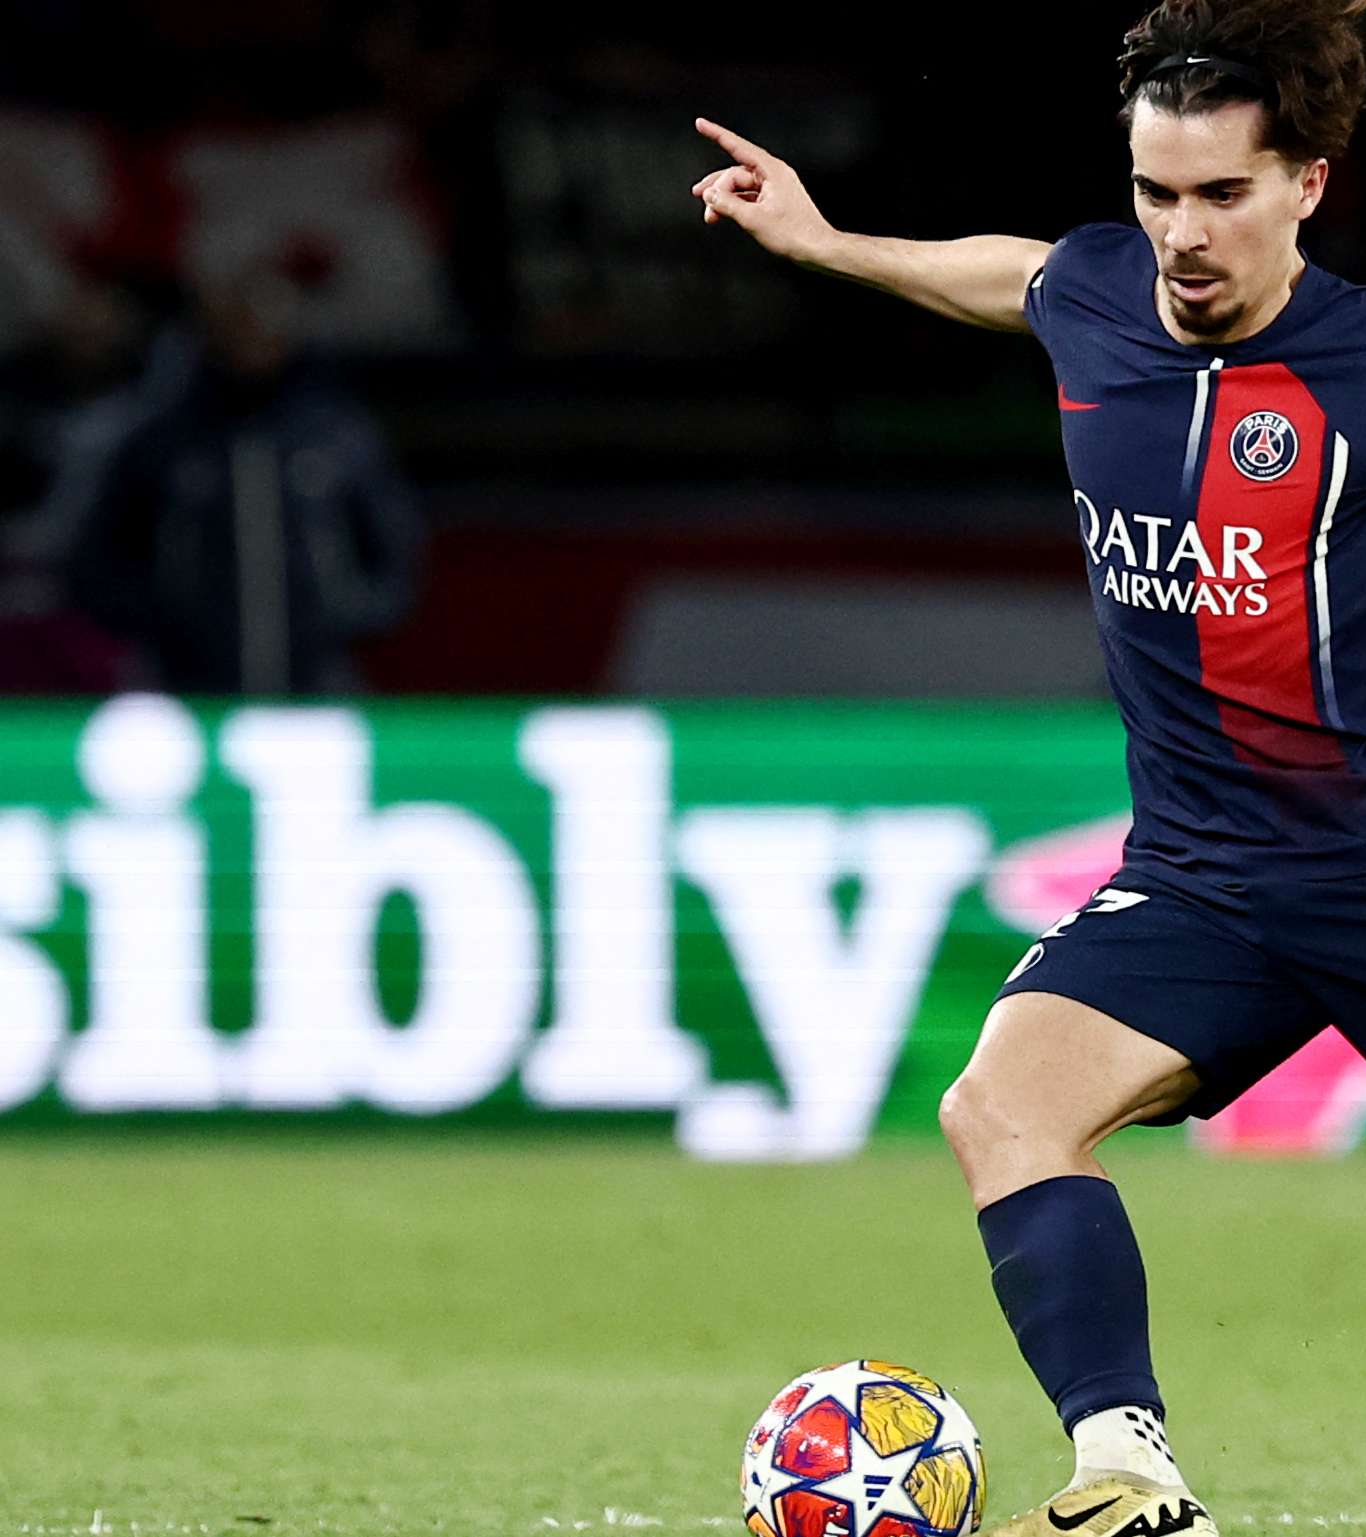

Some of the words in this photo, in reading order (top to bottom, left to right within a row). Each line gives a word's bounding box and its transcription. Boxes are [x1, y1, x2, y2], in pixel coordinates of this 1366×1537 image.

[1244, 415, 1288, 434] PARIS
[1074, 488, 1268, 580] QATAR
[1102, 565, 1268, 616] AIRWAYS
